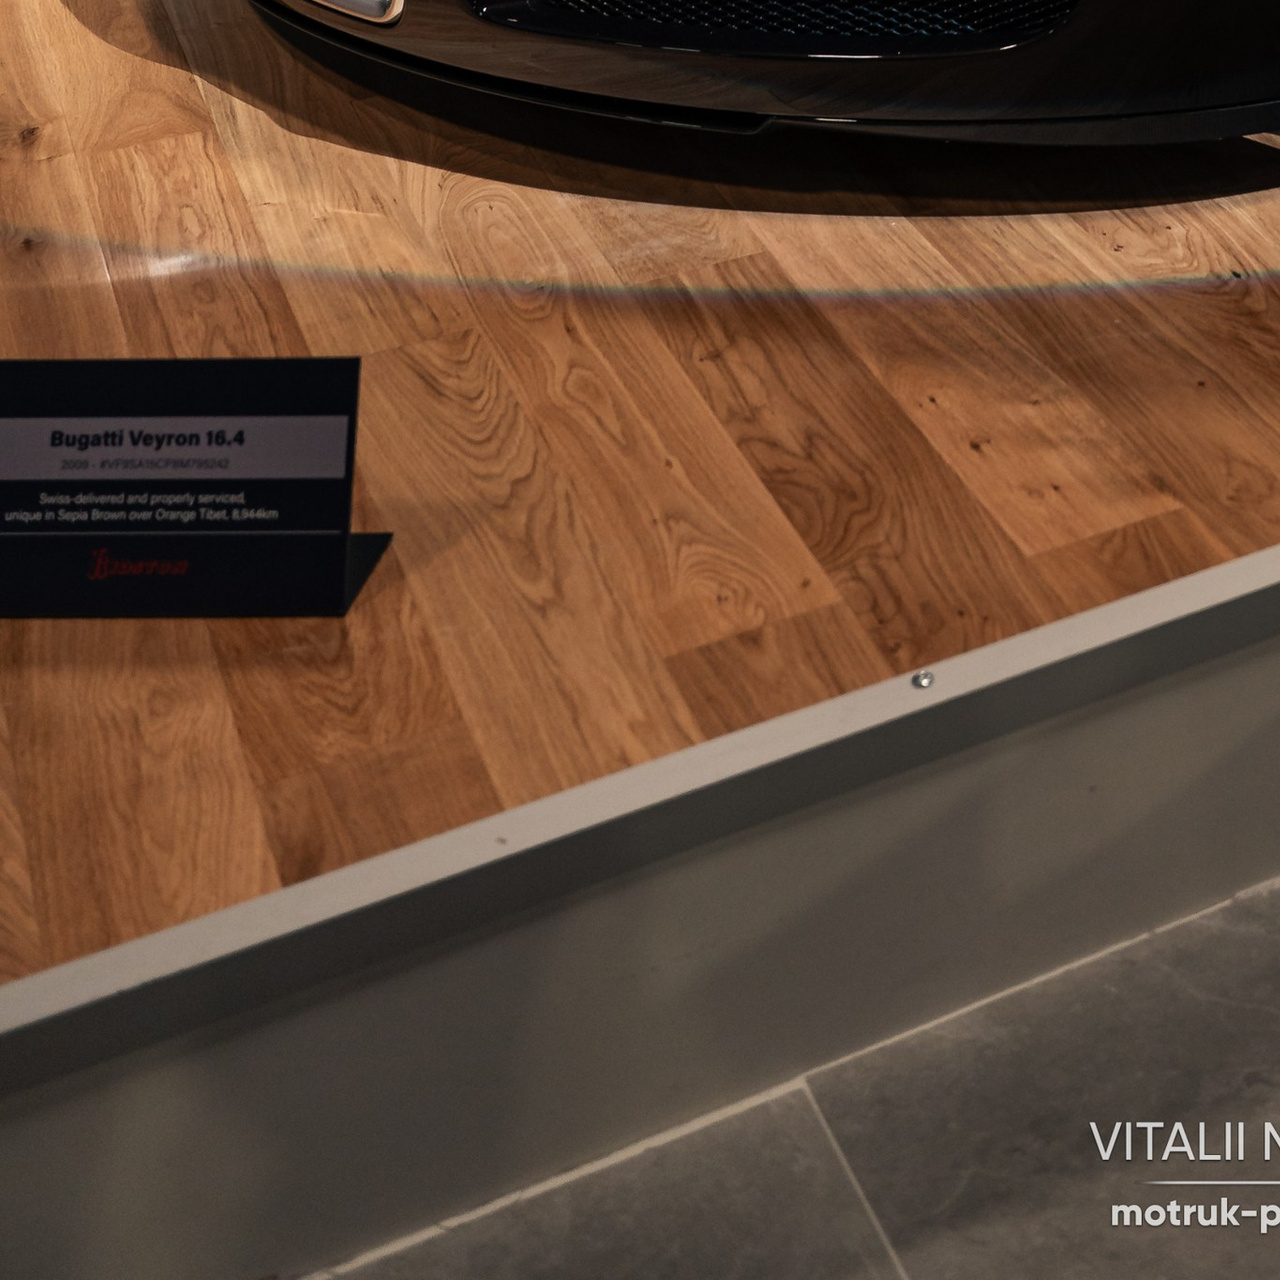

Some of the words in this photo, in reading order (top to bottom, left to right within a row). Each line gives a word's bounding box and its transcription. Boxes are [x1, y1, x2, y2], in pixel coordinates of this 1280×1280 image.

[50, 430, 124, 451] Bugatti
[129, 430, 200, 451] Veyron
[206, 429, 246, 446] 16.4
[40, 492, 125, 505] Swiss-delivered
[127, 492, 148, 504] and
[150, 492, 195, 506] properly
[5, 510, 42, 523] unique
[44, 510, 55, 521] in
[58, 508, 88, 522] Sepia
[91, 508, 127, 521] Brown
[129, 510, 152, 521] over
[155, 508, 196, 524] Orange
